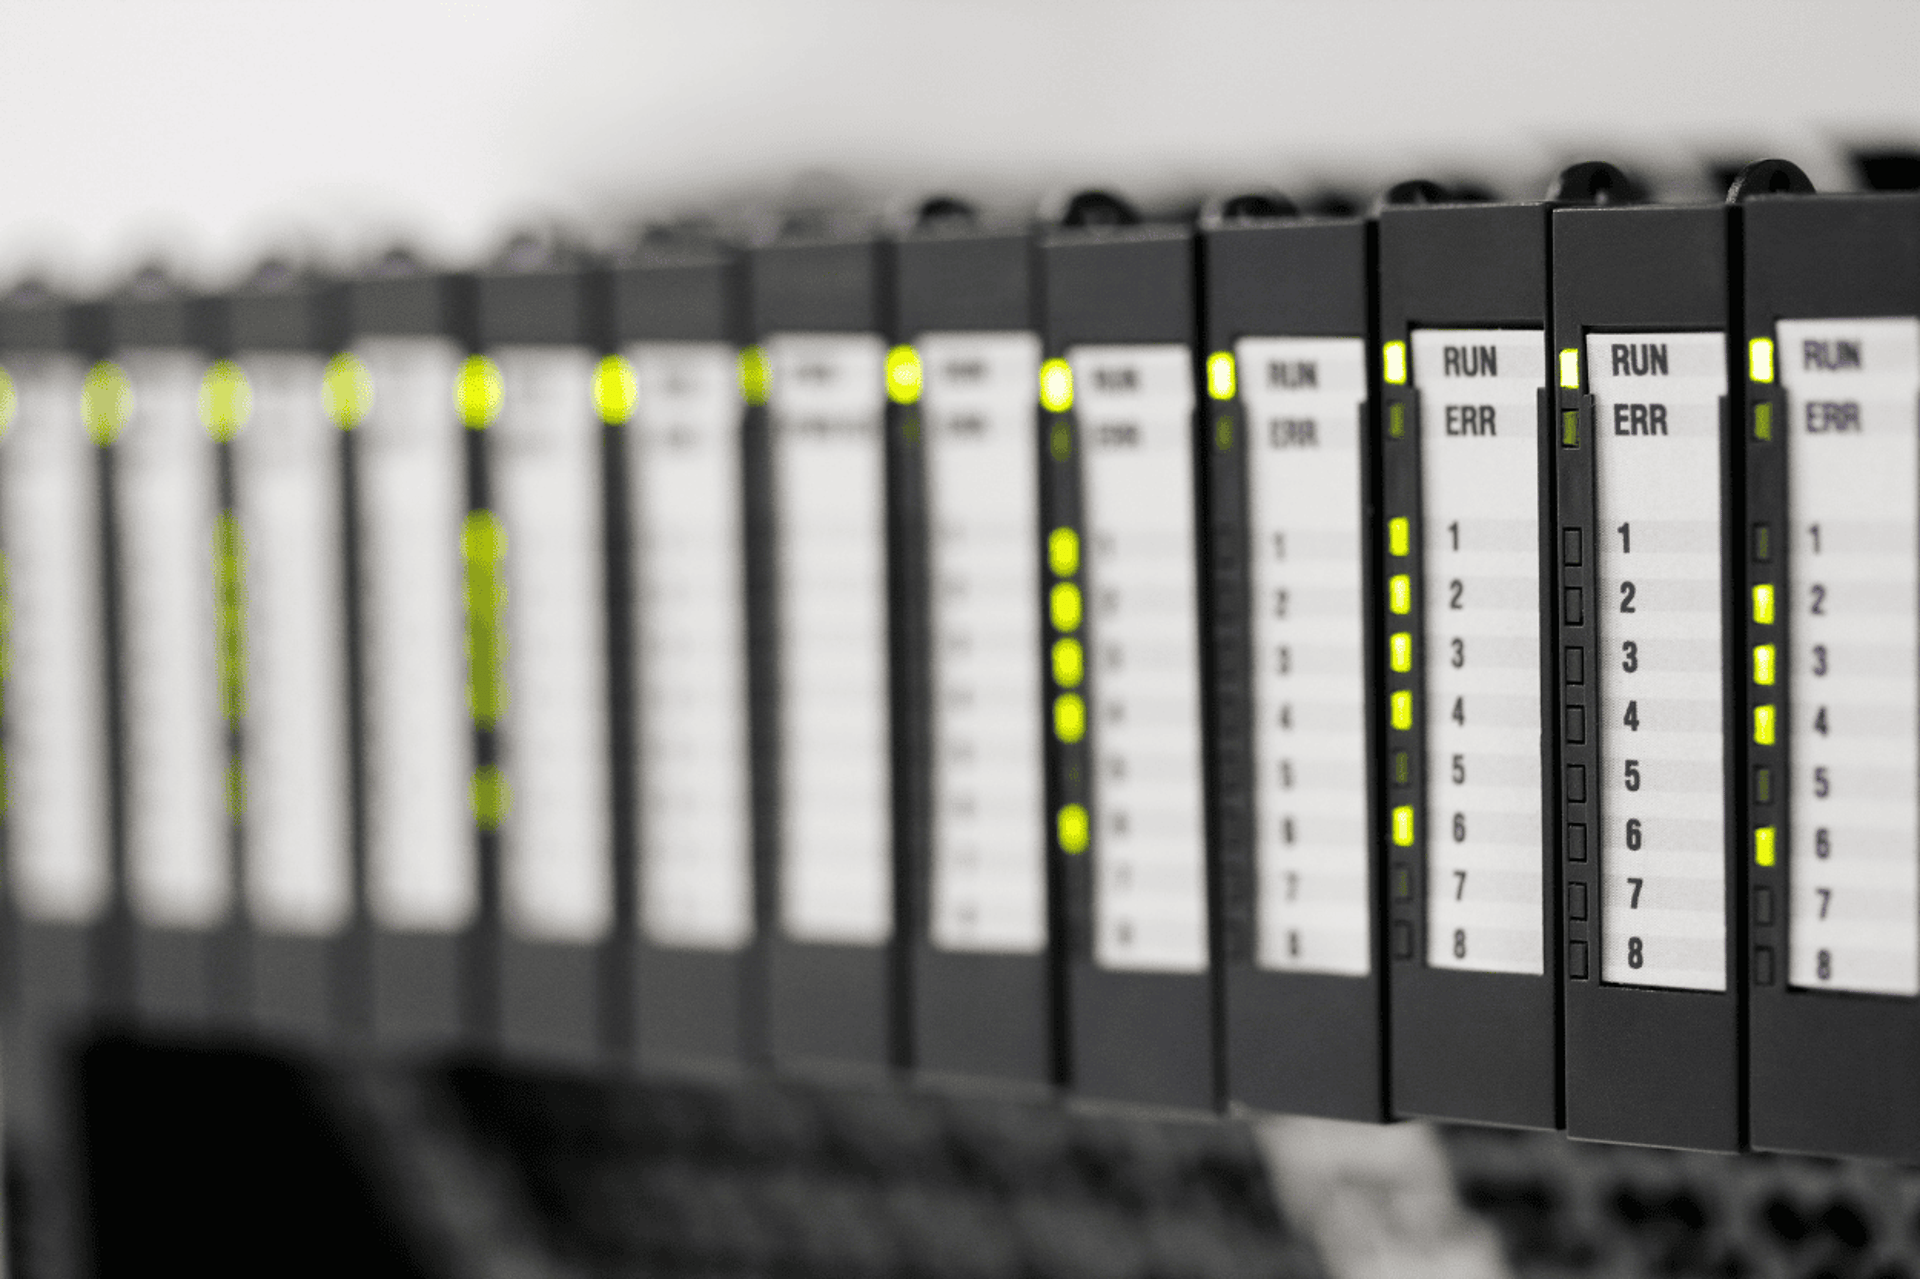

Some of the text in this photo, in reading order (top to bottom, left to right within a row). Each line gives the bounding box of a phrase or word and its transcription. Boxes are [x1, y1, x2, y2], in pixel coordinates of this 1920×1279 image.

[1444, 346, 1497, 377] RUN
[1611, 344, 1668, 376] RUN
[1803, 340, 1861, 371] RUN
[1445, 405, 1496, 436] ERR
[1614, 404, 1668, 436] ERR
[1805, 401, 1860, 433] ERR
[1448, 522, 1459, 551] 1
[1617, 522, 1630, 553] 1
[1809, 524, 1821, 554] 1
[1450, 579, 1463, 610] 2
[1620, 581, 1636, 613] 2
[1810, 584, 1826, 615] 2
[1451, 637, 1465, 669] 3
[1622, 640, 1638, 673] 3
[1812, 645, 1828, 677] 3
[1452, 696, 1465, 726] 4
[1623, 700, 1639, 731] 4
[1814, 707, 1829, 736] 4
[1452, 754, 1465, 785] 5
[1625, 760, 1640, 791] 5
[1814, 767, 1830, 799] 5
[1453, 812, 1466, 843] 6
[1626, 818, 1642, 851] 6
[1815, 828, 1831, 860] 6
[1453, 870, 1467, 901] 7
[1627, 878, 1643, 909] 7
[1816, 888, 1832, 919] 7
[1453, 928, 1466, 959] 8
[1628, 937, 1643, 969] 8
[1815, 949, 1831, 982] 8
